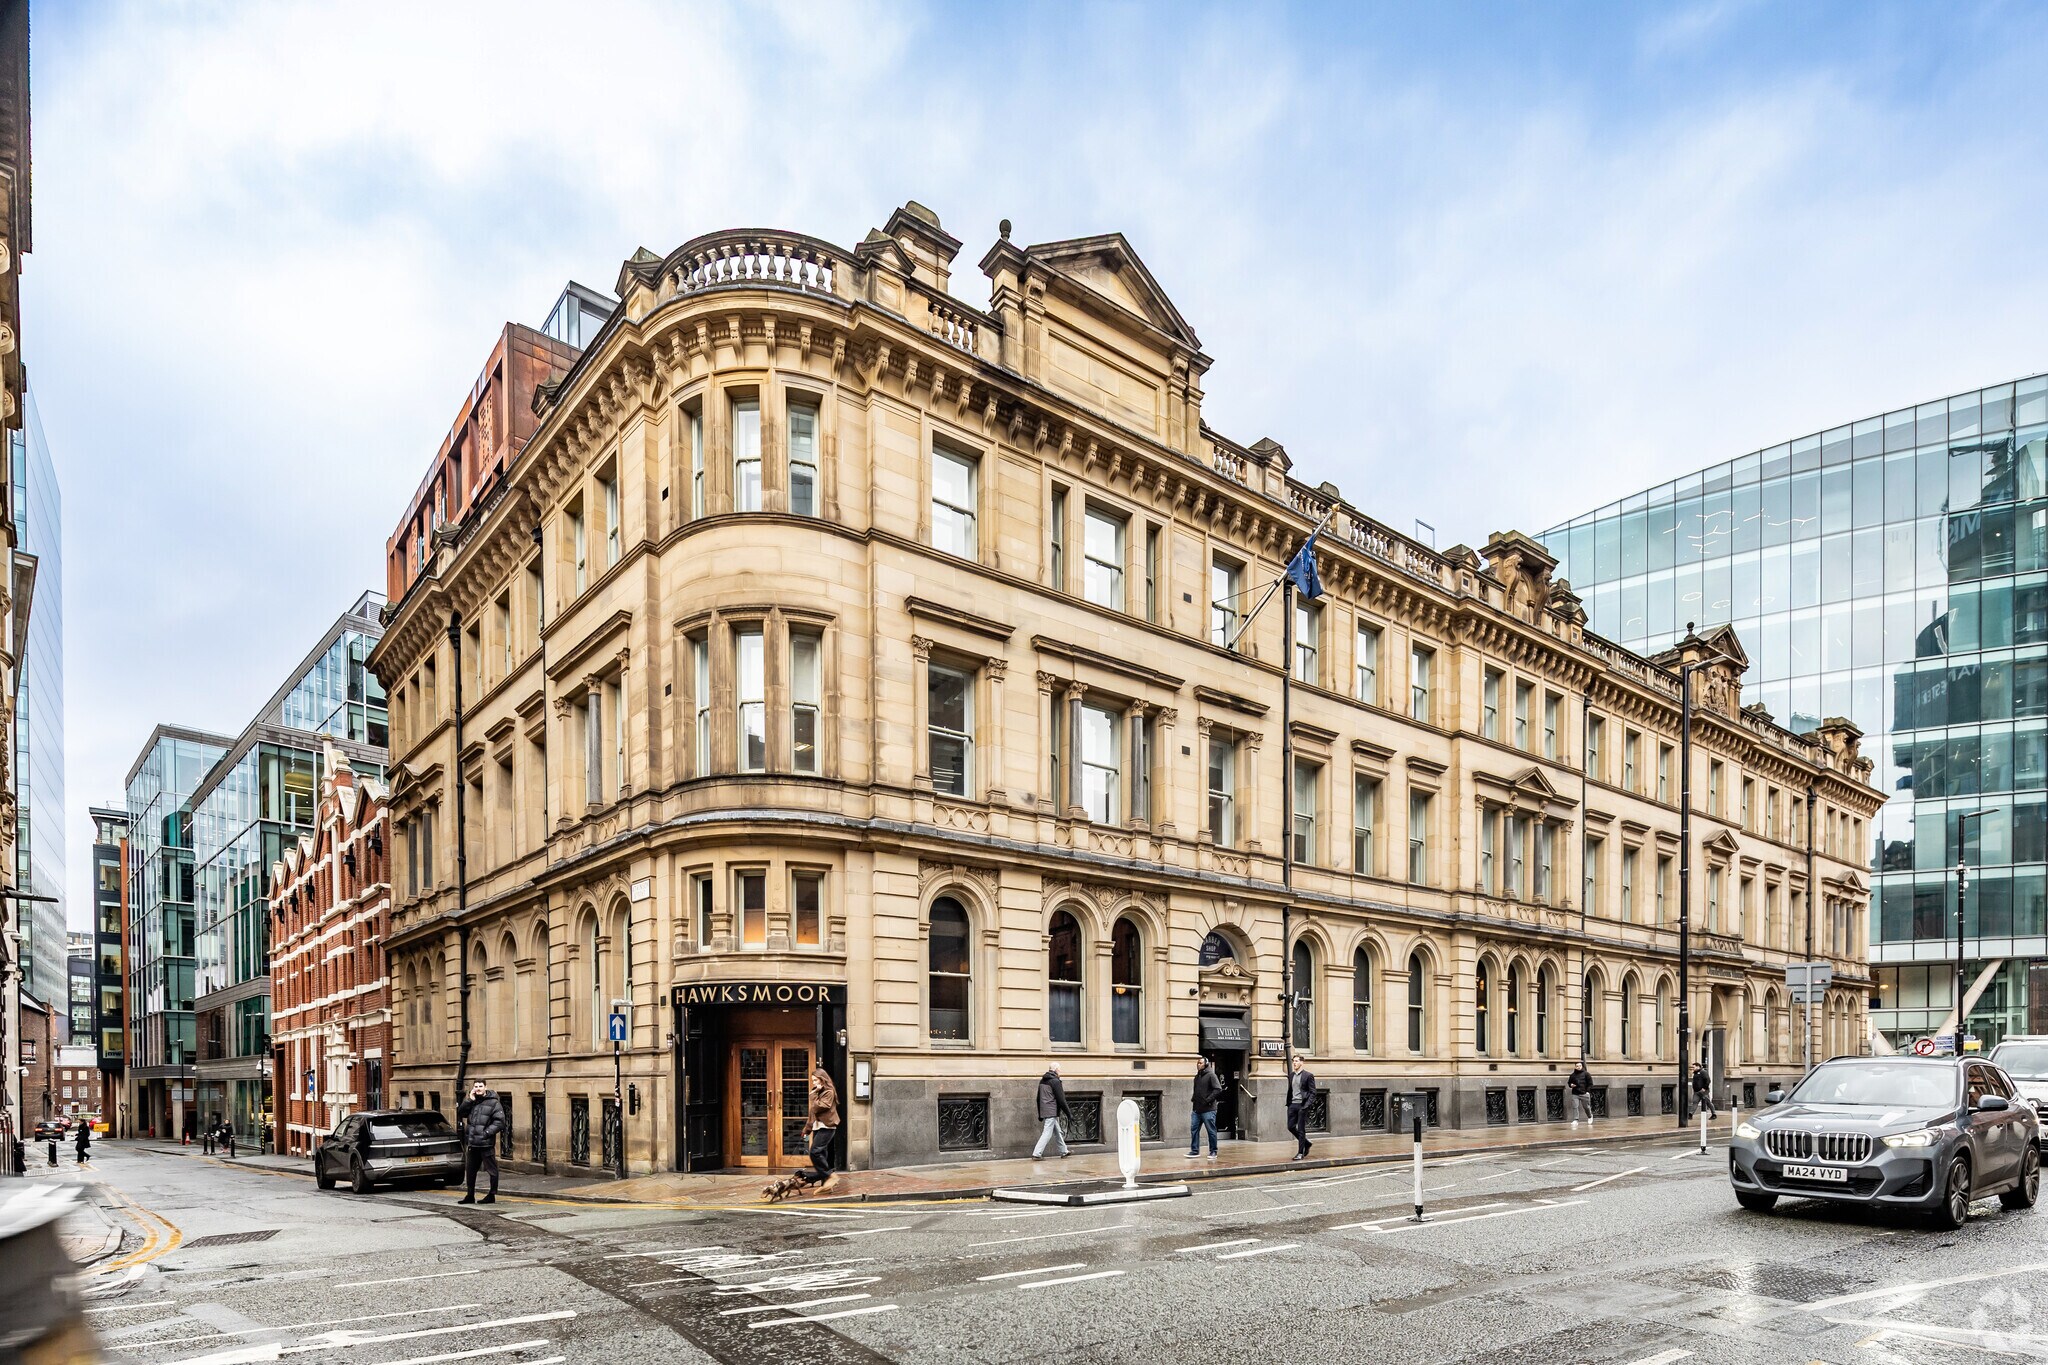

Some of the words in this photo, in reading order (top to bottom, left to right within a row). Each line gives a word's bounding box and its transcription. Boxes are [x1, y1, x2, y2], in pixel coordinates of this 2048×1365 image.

[675, 985, 831, 1004] HAWKSMOOR
[1787, 1166, 1816, 1178] MA24
[1819, 1168, 1842, 1179] VYD
